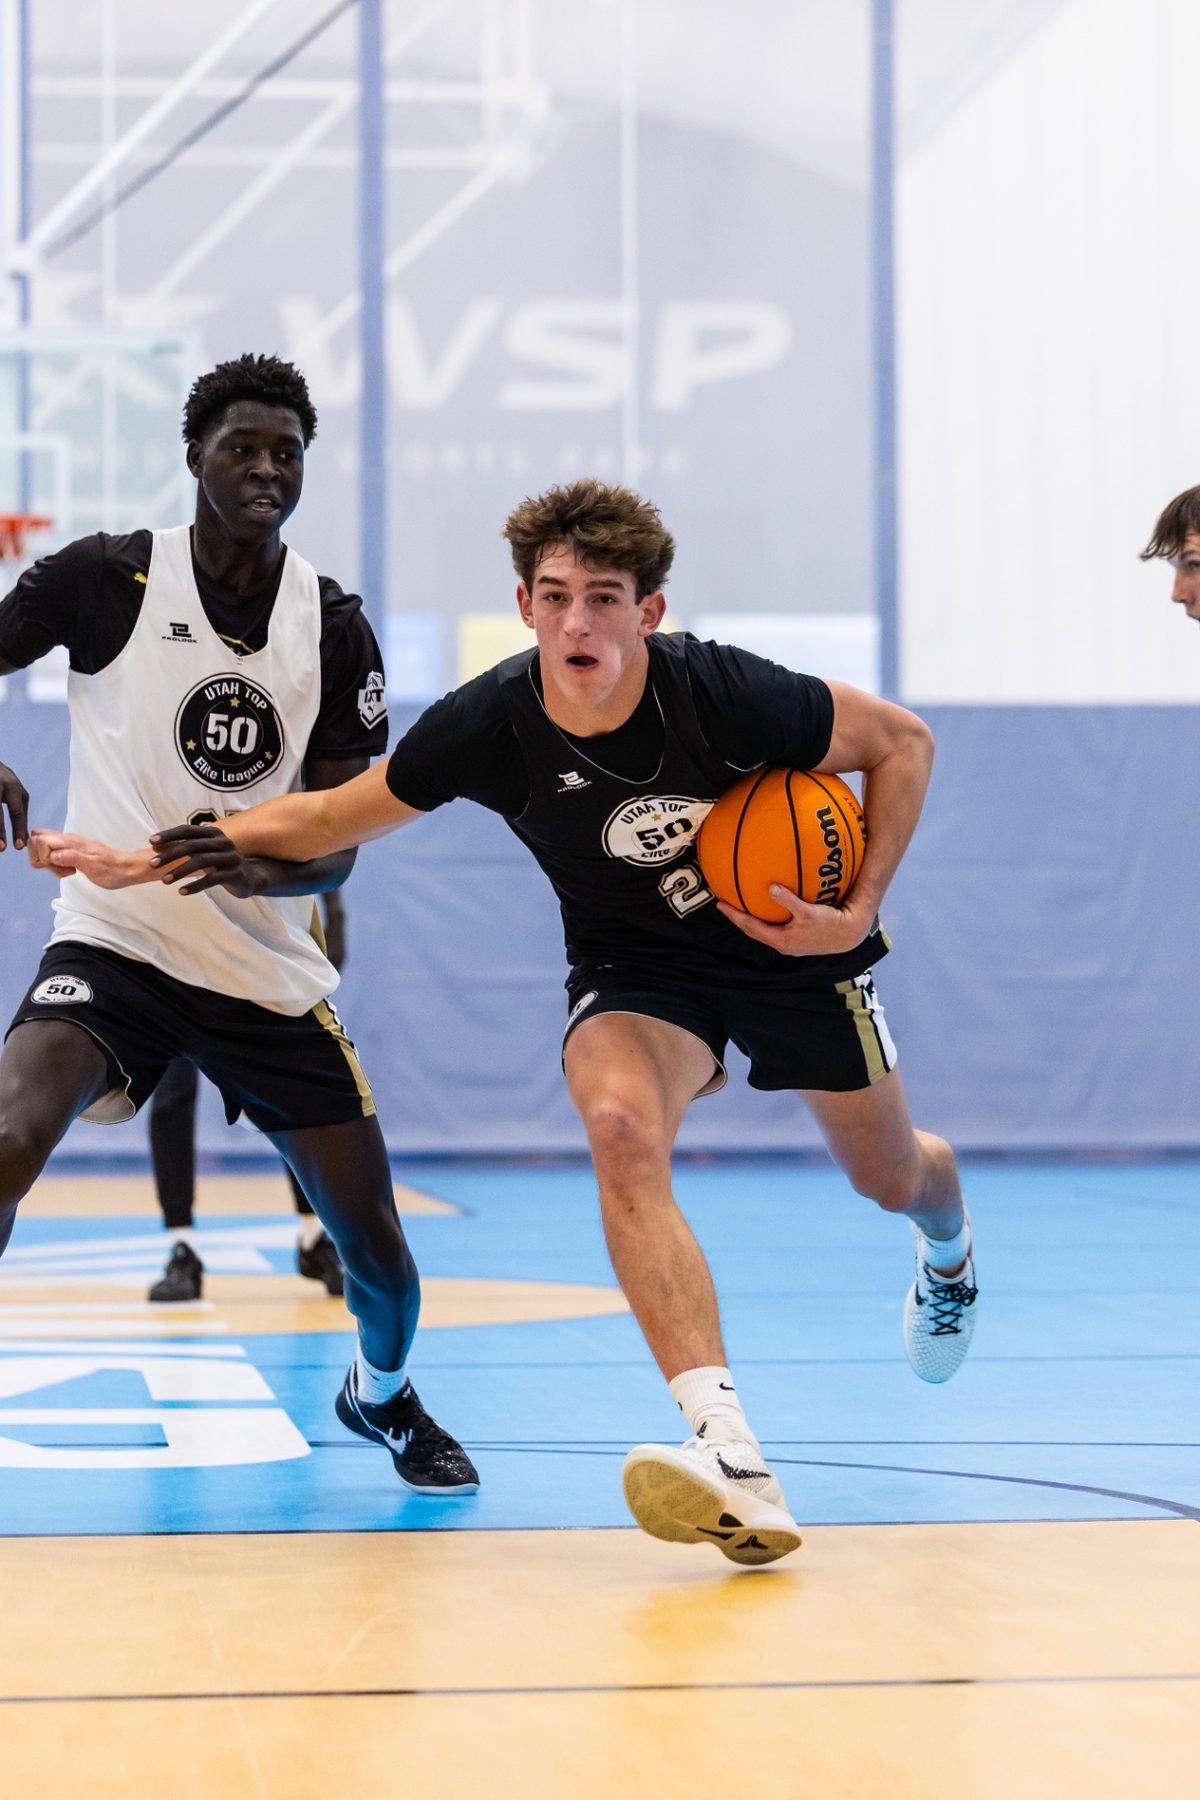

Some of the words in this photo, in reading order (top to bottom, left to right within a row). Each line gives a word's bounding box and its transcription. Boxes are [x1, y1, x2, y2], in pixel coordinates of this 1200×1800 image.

[279, 295, 793, 412] WSP
[204, 682, 240, 701] UTAH
[244, 686, 268, 710] TOP
[205, 712, 258, 755] 50
[193, 756, 218, 780] Elite
[222, 760, 266, 783] League
[620, 803, 656, 825] UTAH
[636, 817, 694, 851] 50
[46, 984, 77, 996] 50
